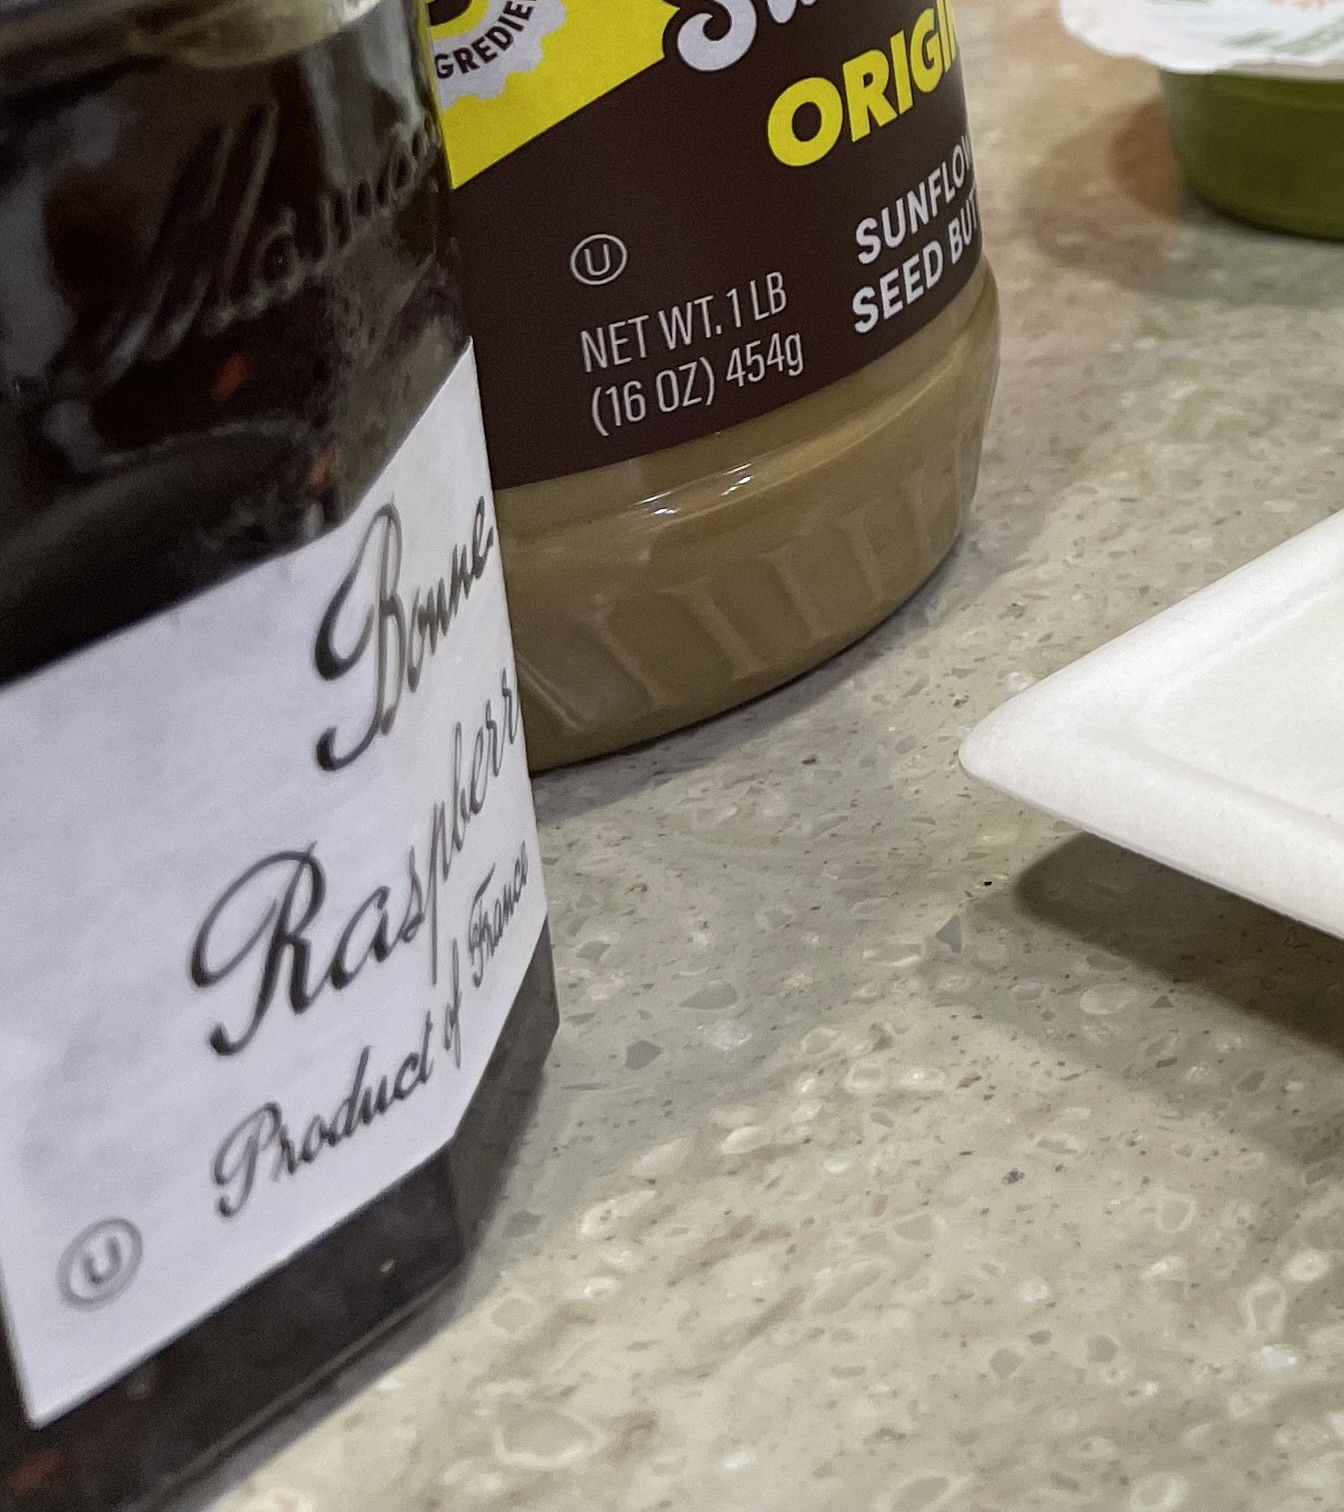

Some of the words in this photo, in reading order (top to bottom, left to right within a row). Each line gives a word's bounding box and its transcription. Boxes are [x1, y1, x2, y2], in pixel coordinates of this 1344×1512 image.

[579, 315, 650, 374] NET
[658, 295, 723, 351] WT.
[727, 288, 744, 329] 1
[750, 271, 788, 322] LB
[851, 239, 944, 334] SEED
[947, 184, 979, 265] BUT
[591, 380, 647, 437] (16
[656, 357, 715, 413] OZ)
[725, 332, 804, 388] 454g
[314, 492, 494, 772] Bonne
[189, 666, 520, 1058] Raspberr
[213, 1009, 435, 1219] Product
[444, 936, 462, 1070] of
